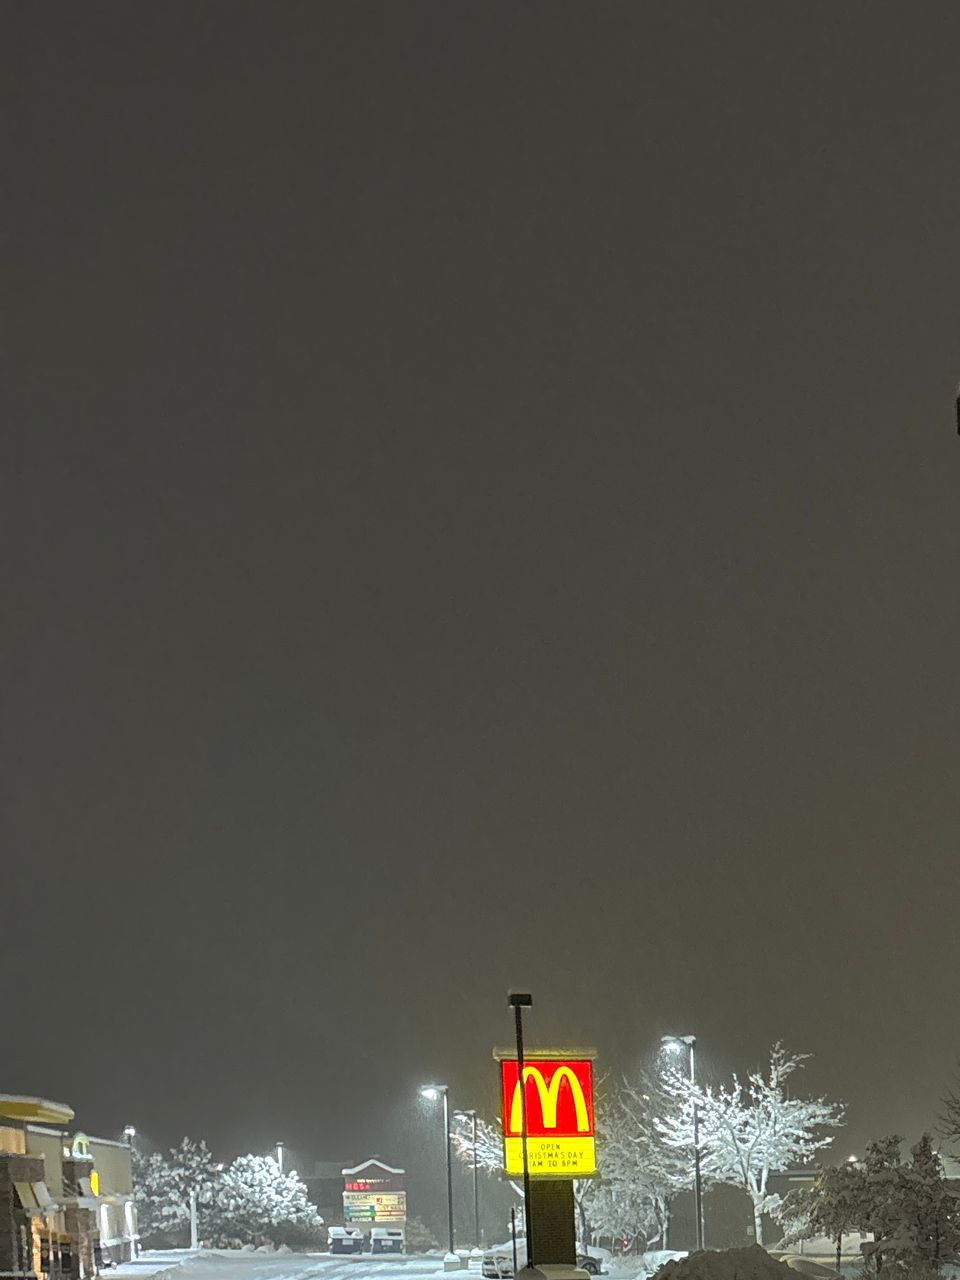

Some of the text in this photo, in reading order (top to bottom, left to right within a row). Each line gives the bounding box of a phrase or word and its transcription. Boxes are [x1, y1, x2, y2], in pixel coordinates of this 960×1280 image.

[540, 1143, 561, 1151] OPEN
[518, 1151, 584, 1160] CRISTMAS DAY
